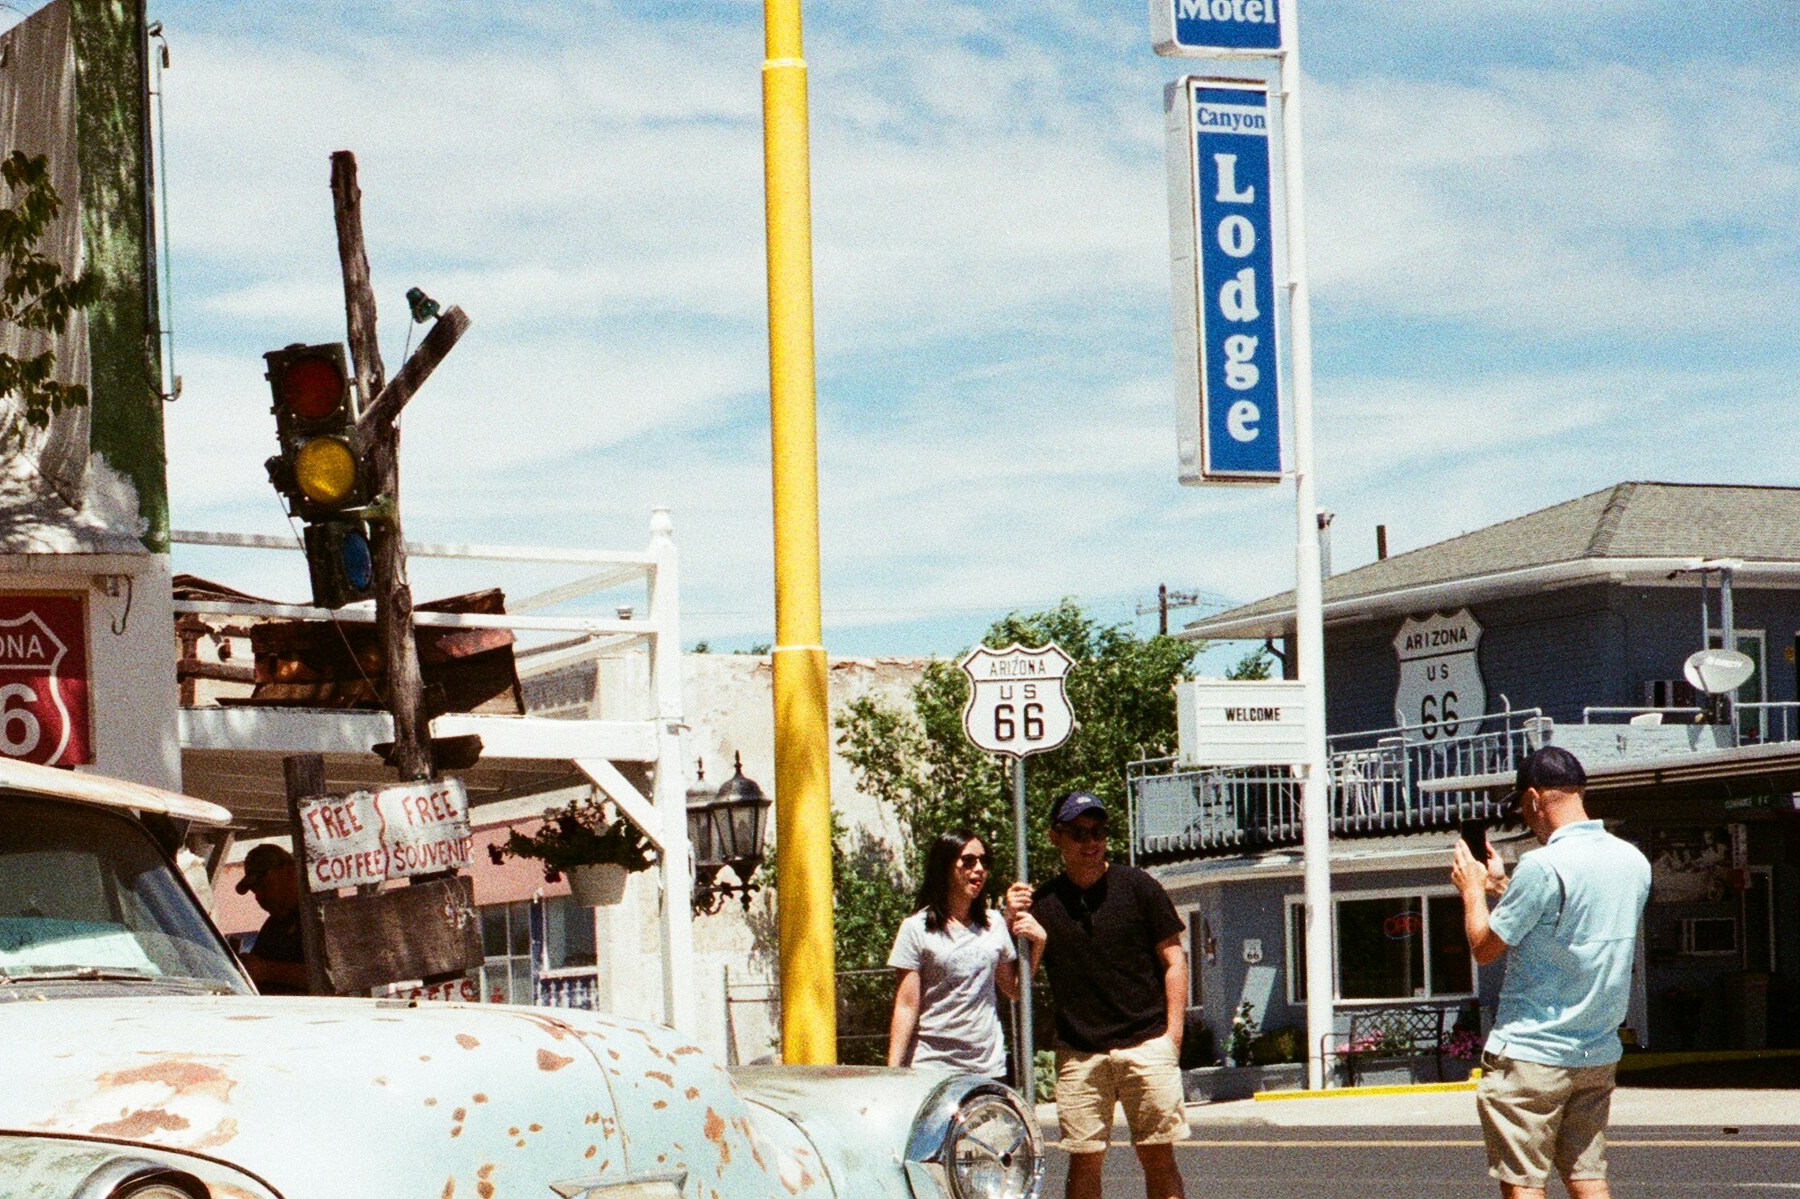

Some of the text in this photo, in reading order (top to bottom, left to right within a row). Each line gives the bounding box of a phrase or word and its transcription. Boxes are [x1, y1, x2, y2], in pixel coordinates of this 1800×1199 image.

[1178, 0, 1276, 23] Motel
[1197, 107, 1266, 131] Canyon
[1214, 153, 1261, 443] Lodge
[1405, 627, 1468, 651] ARIZONA
[990, 658, 1046, 677] ARIZONA
[994, 703, 1044, 741] 66
[1225, 707, 1281, 721] WELCOME
[1421, 691, 1460, 740] 66
[307, 801, 364, 840] FREE
[402, 790, 458, 826] FREE
[316, 849, 384, 883] COFFEE
